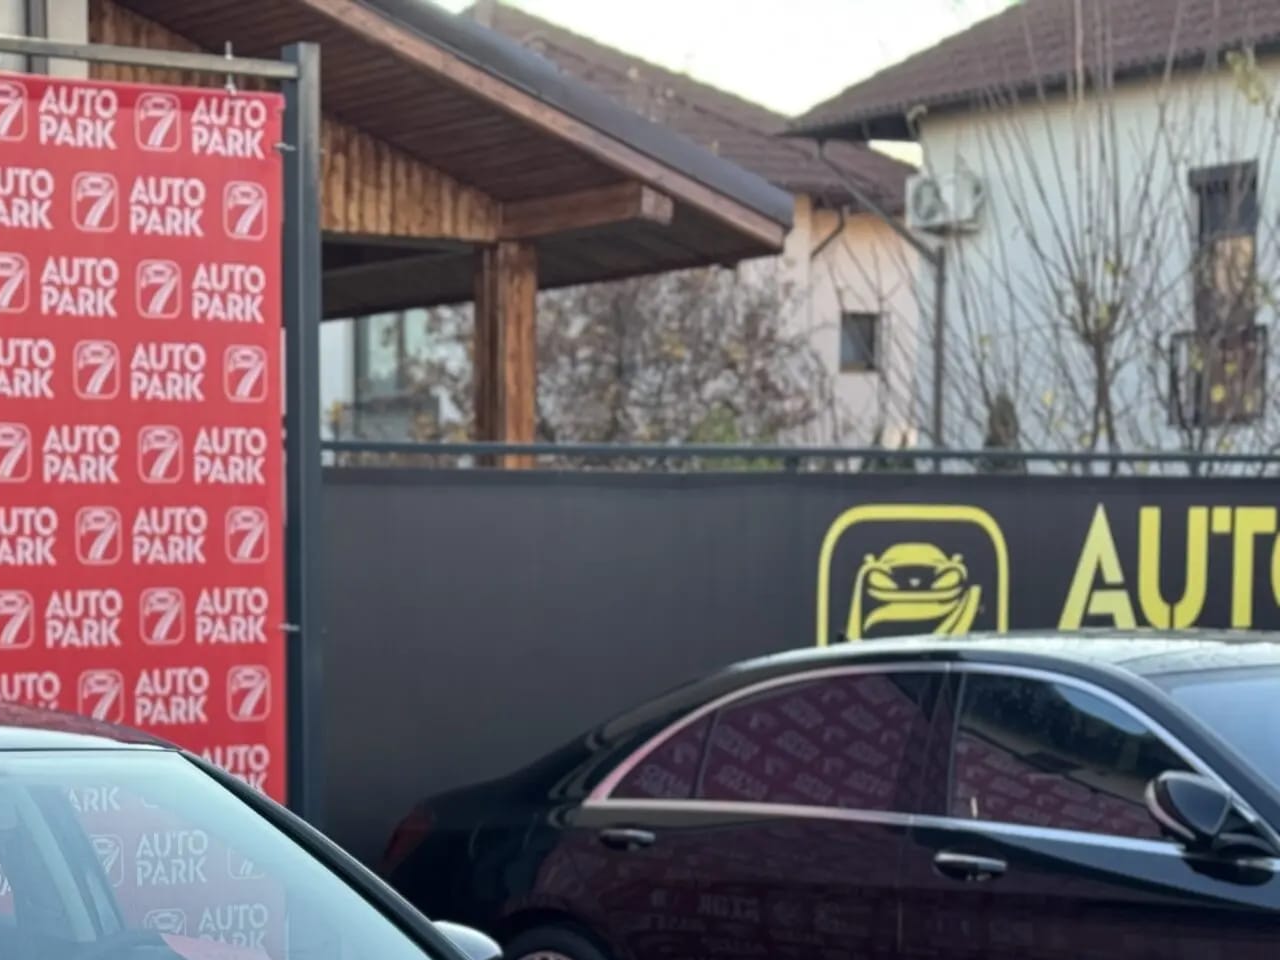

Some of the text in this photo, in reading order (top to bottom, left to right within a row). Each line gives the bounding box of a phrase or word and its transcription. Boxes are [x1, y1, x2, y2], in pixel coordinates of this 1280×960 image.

[37, 85, 118, 119] AUTO
[189, 98, 266, 128] AUTO
[37, 113, 117, 150] PARK
[190, 124, 264, 159] PARK
[129, 176, 206, 207] AUTO
[129, 206, 204, 238] PARK
[40, 256, 120, 287] AUTO
[192, 263, 265, 295] AUTO
[40, 286, 117, 317] PARK
[192, 290, 264, 323] PARK
[130, 342, 206, 372] AUTO
[130, 371, 204, 402] PARK
[42, 424, 121, 454] AUTO
[193, 427, 267, 456] AUTO
[42, 453, 119, 484] PARK
[193, 455, 265, 484] PARK
[132, 506, 208, 535] AUTO
[132, 534, 206, 565] PARK
[1058, 503, 1280, 631] AUT
[44, 588, 123, 619] AUTO
[195, 586, 269, 617] AUTO
[45, 616, 122, 648] PARK
[195, 614, 267, 645] PARK
[134, 666, 210, 697] AUTO
[133, 695, 208, 726] PARK
[136, 858, 207, 888] PARK
